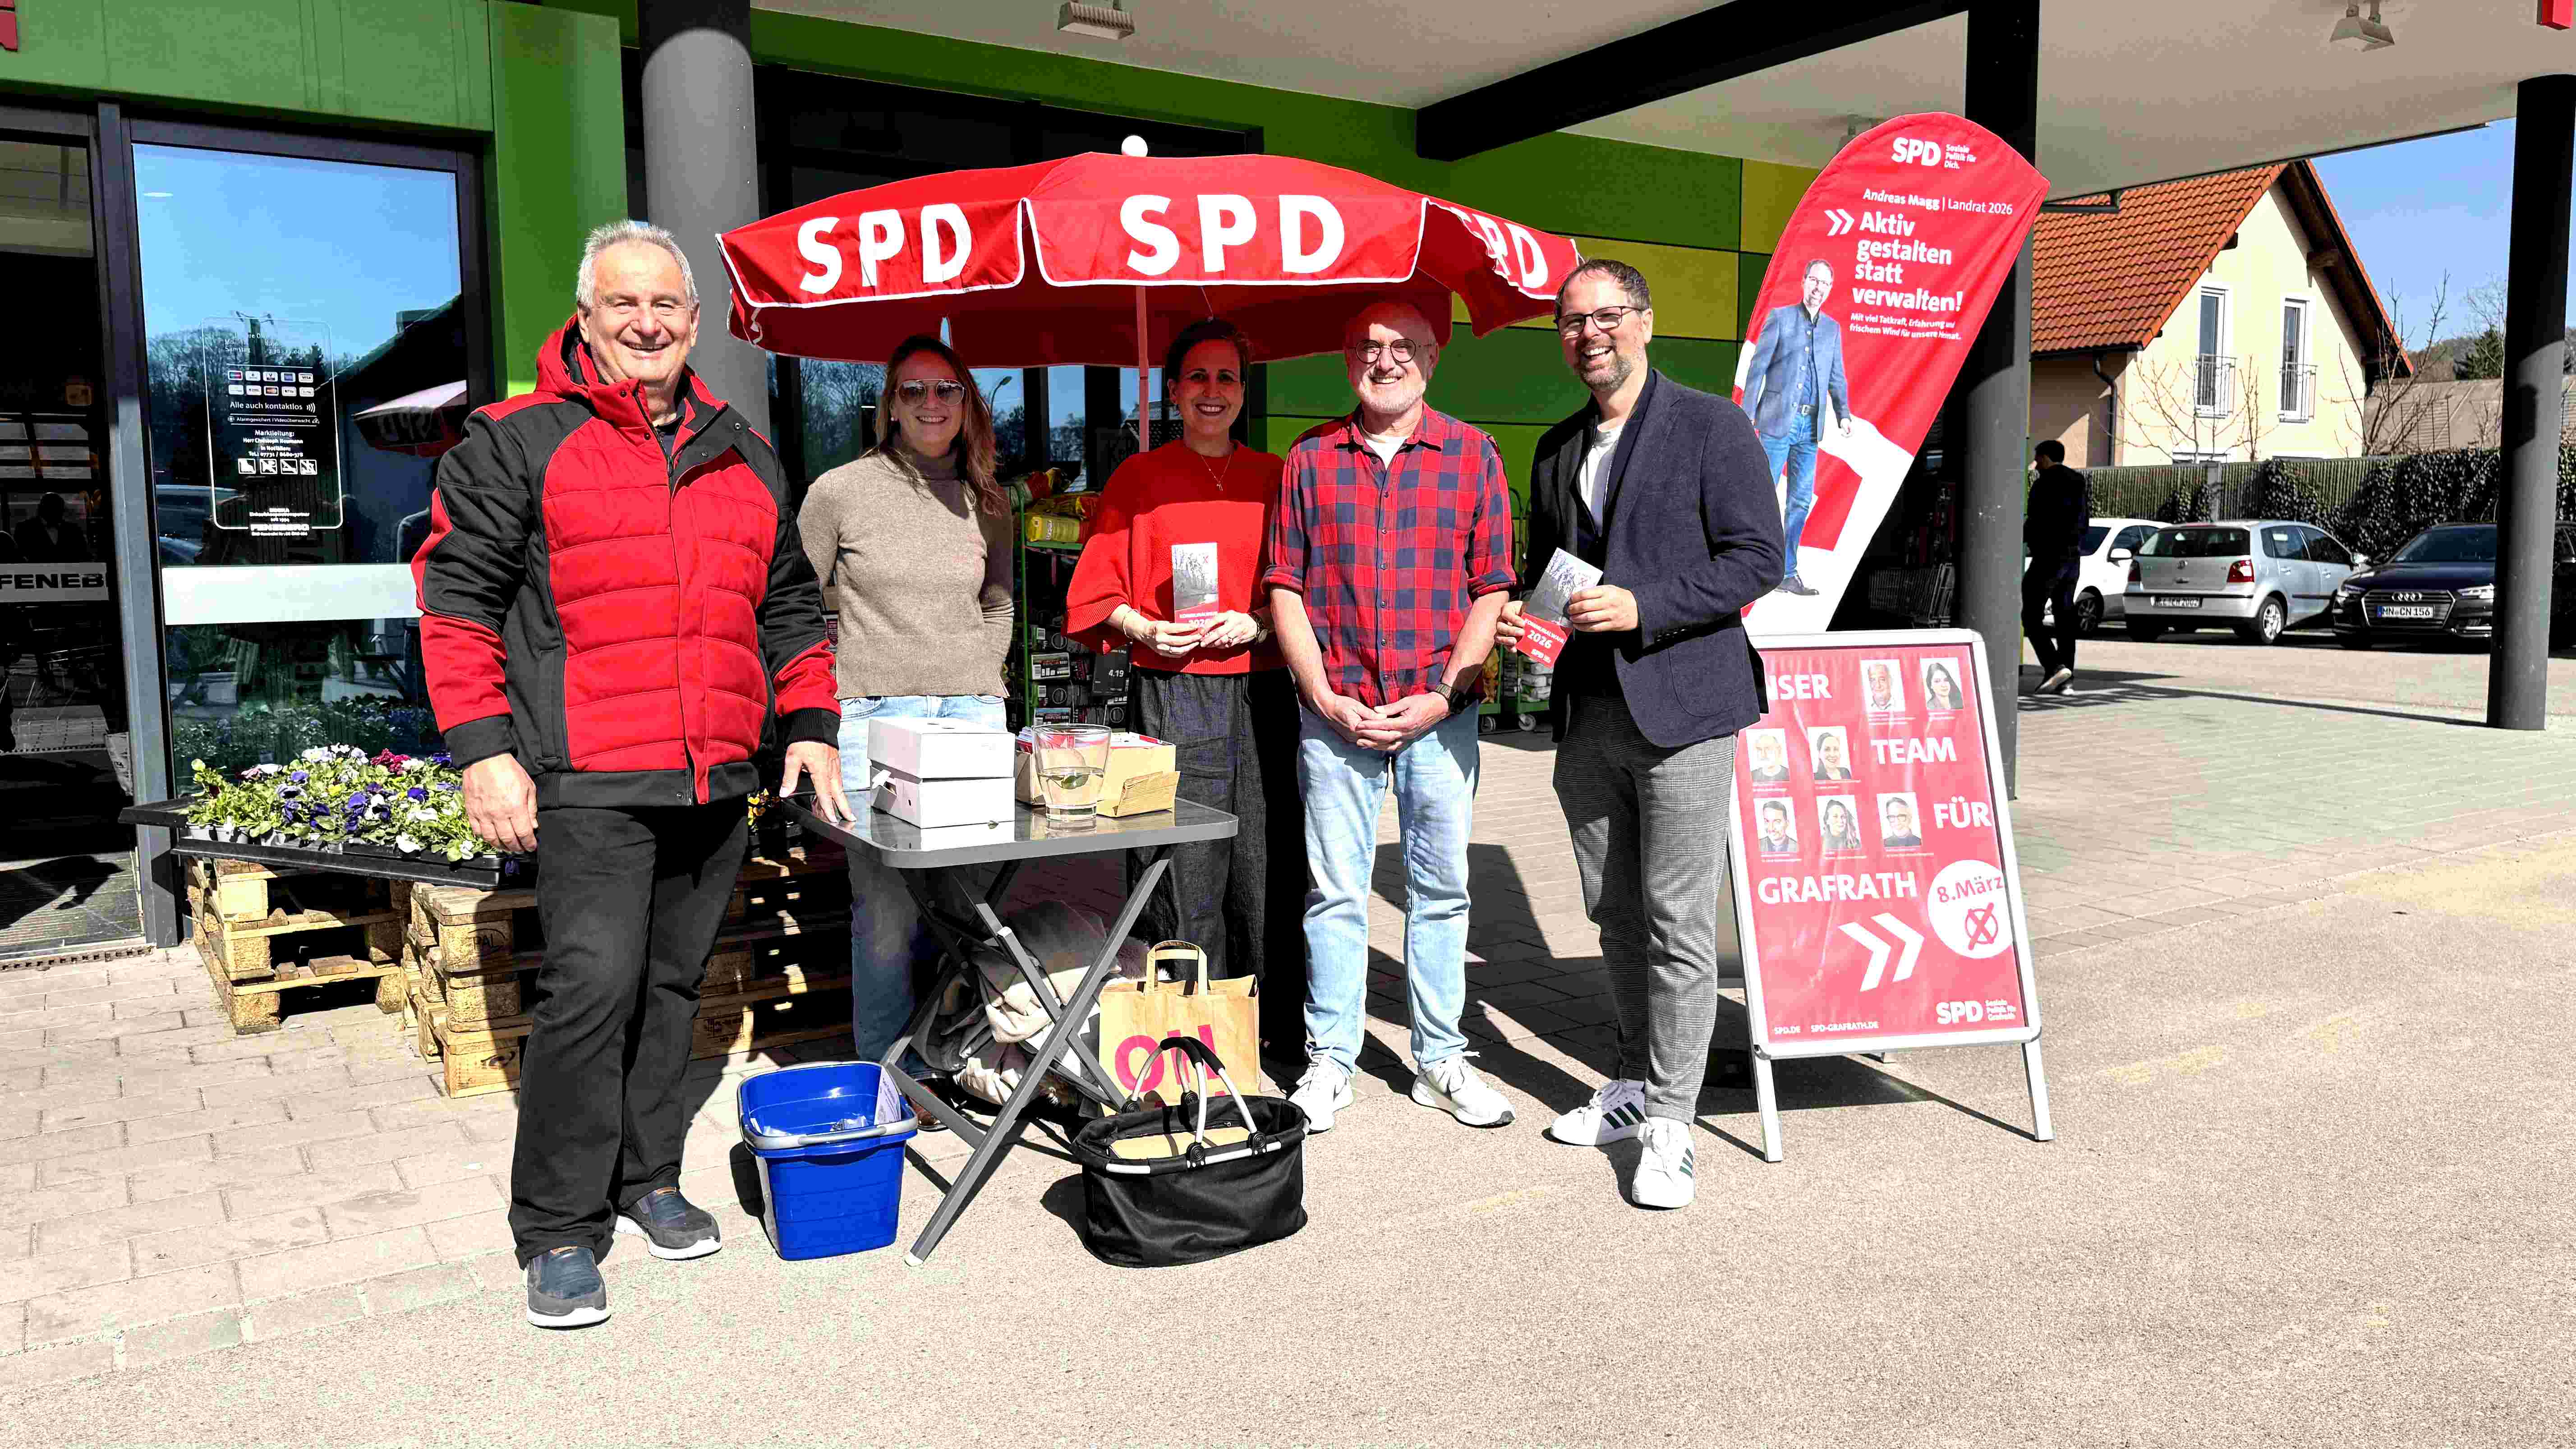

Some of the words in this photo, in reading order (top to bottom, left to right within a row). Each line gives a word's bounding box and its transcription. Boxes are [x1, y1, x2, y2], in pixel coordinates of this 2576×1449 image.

[1891, 137, 1941, 166] SPD
[1946, 144, 1969, 153] Soziale
[1946, 152, 1966, 161] Politik
[1966, 154, 1977, 162] für
[1944, 161, 1960, 169] Dich.
[1863, 188, 1906, 204] Andreas
[1908, 194, 1940, 210] Magg
[1948, 198, 1986, 212] Landrat
[1988, 202, 2013, 215] 2026
[1120, 195, 1344, 276] SPD
[1859, 212, 1915, 236] Aktiv
[798, 203, 972, 294] SPD
[1856, 239, 1952, 265] gestalten
[1854, 260, 1904, 284] statt
[1852, 288, 1963, 312] verwalten!
[1849, 323, 1881, 335] frischem
[1882, 327, 1901, 336] Wind
[1900, 329, 1910, 337] für
[1850, 313, 1863, 321] Mit
[1865, 315, 1878, 323] viel
[1880, 315, 1907, 327] Tatkraft,
[1909, 318, 1945, 329] Erfahrung
[2382, 607, 2394, 616] MN
[2400, 607, 2411, 616] CN
[2414, 607, 2430, 616] 156
[1527, 630, 1552, 649] 2026
[1767, 674, 1832, 700] NSER
[1871, 737, 1957, 765] TEAM
[1934, 796, 1992, 828] FÜR
[1757, 871, 1918, 904] GRAFRATH
[1936, 1000, 1983, 1025] SPD
[1774, 1026, 1801, 1034] SPD.DE
[1811, 1021, 1879, 1032] SPD-GRAFRATH.DE
